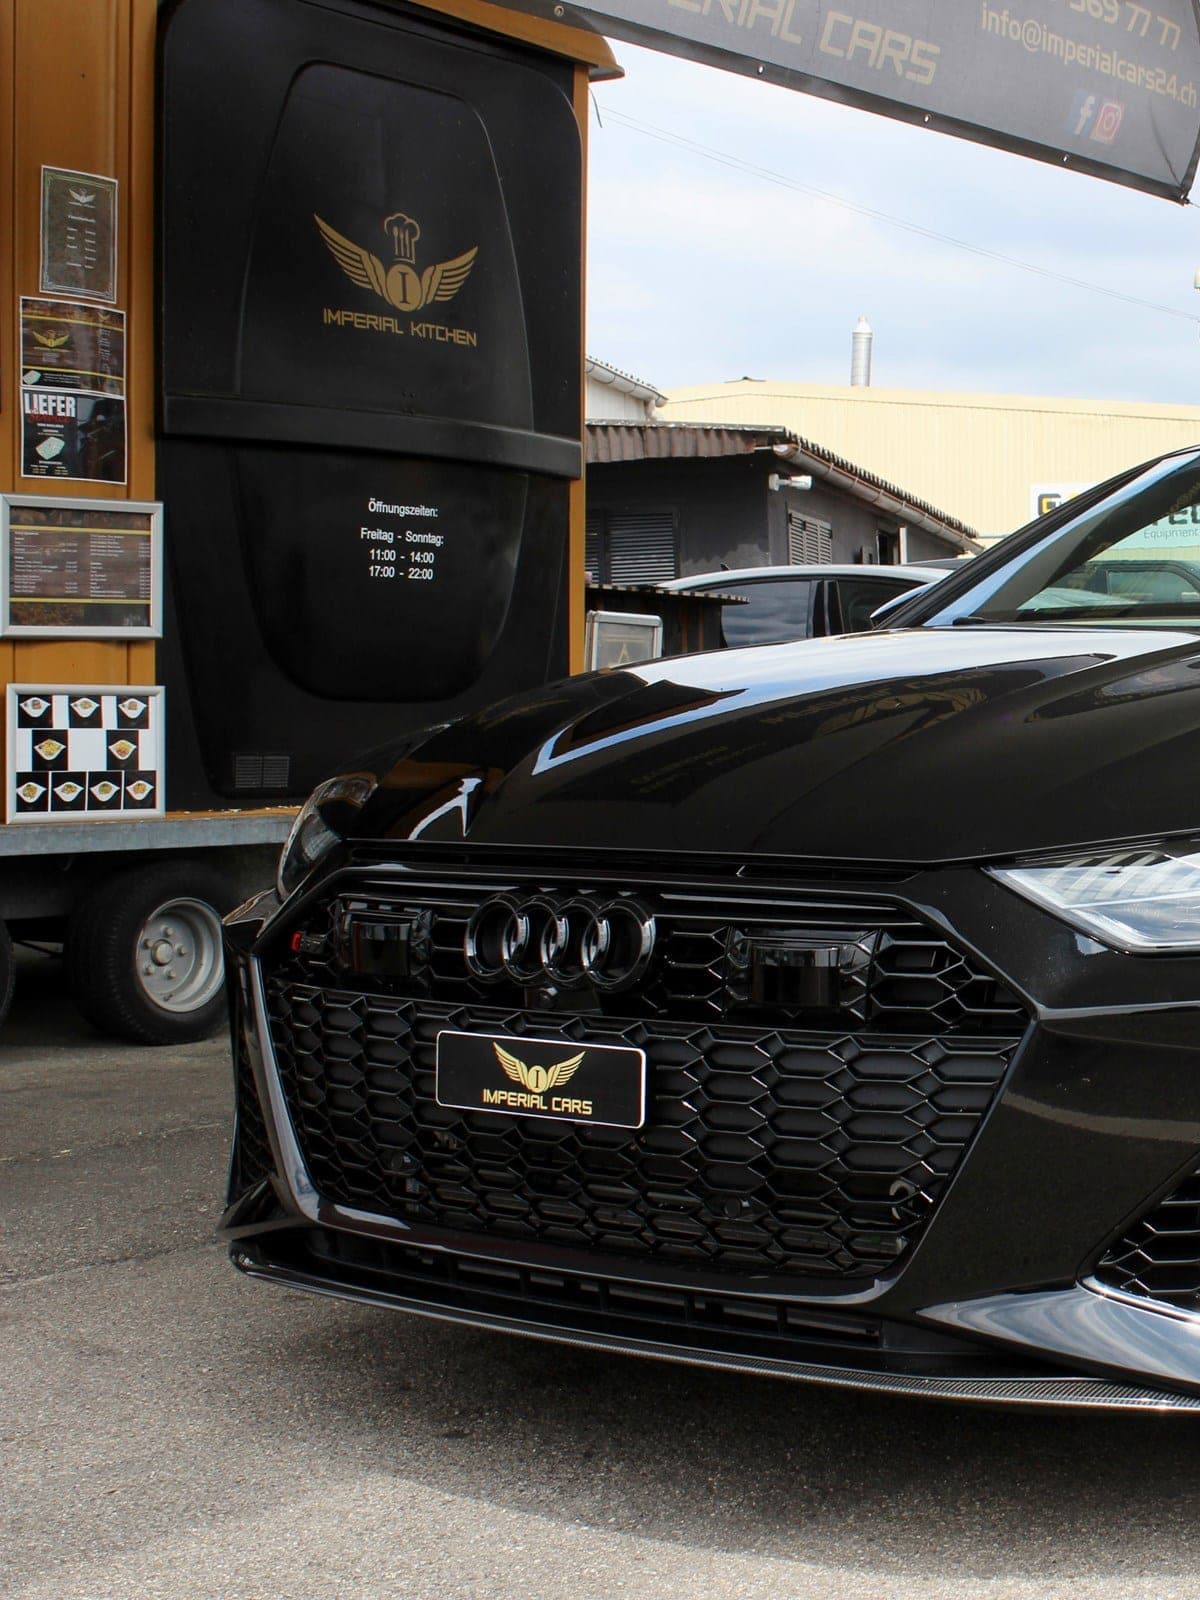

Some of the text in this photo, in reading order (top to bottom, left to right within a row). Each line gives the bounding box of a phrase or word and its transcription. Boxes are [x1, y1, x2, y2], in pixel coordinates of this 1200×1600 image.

[1125, 2, 1152, 37] 77
[1157, 15, 1181, 50] 77
[819, 9, 940, 86] CARS
[981, 5, 1197, 109] info@imperialcars24.ch
[323, 307, 477, 347] IMPERIAL KITCHEN
[24, 392, 76, 418] LIEFER
[368, 497, 438, 518] Öffnungszeiten:
[360, 527, 394, 544] Freitag
[405, 530, 444, 547] Sonntag:
[1143, 527, 1199, 541] Equipment
[369, 548, 396, 561] 11:00
[410, 551, 435, 564] 14:00
[369, 565, 395, 578] 17:00
[408, 567, 433, 580] 22:00
[483, 1088, 593, 1115] IMPERIAL CARS
